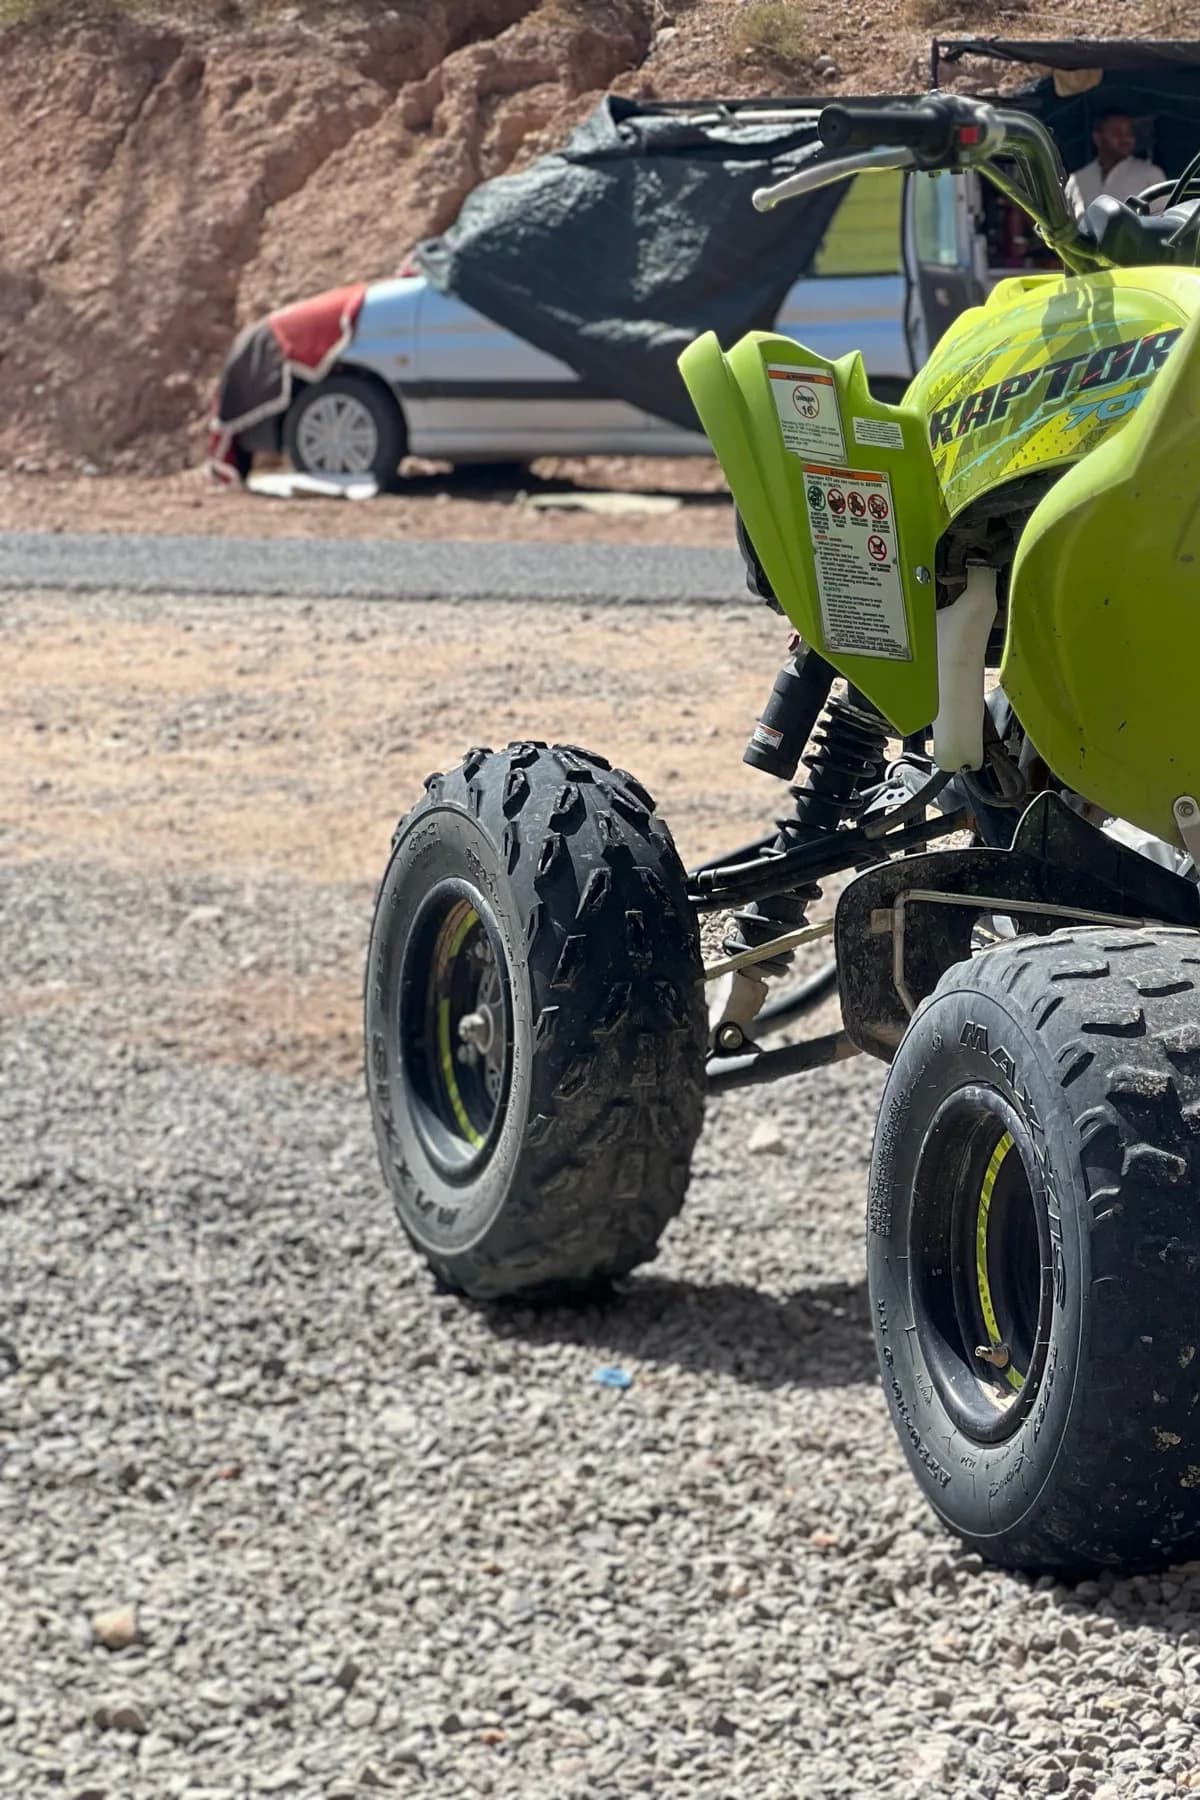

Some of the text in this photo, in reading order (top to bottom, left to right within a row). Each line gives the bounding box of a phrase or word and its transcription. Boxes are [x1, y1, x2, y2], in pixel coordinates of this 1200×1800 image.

[802, 405, 814, 416] 16
[930, 328, 1184, 449] RAPTOR
[372, 1033, 460, 1230] MAXXIS
[959, 1020, 1066, 1311] MAXXIS
